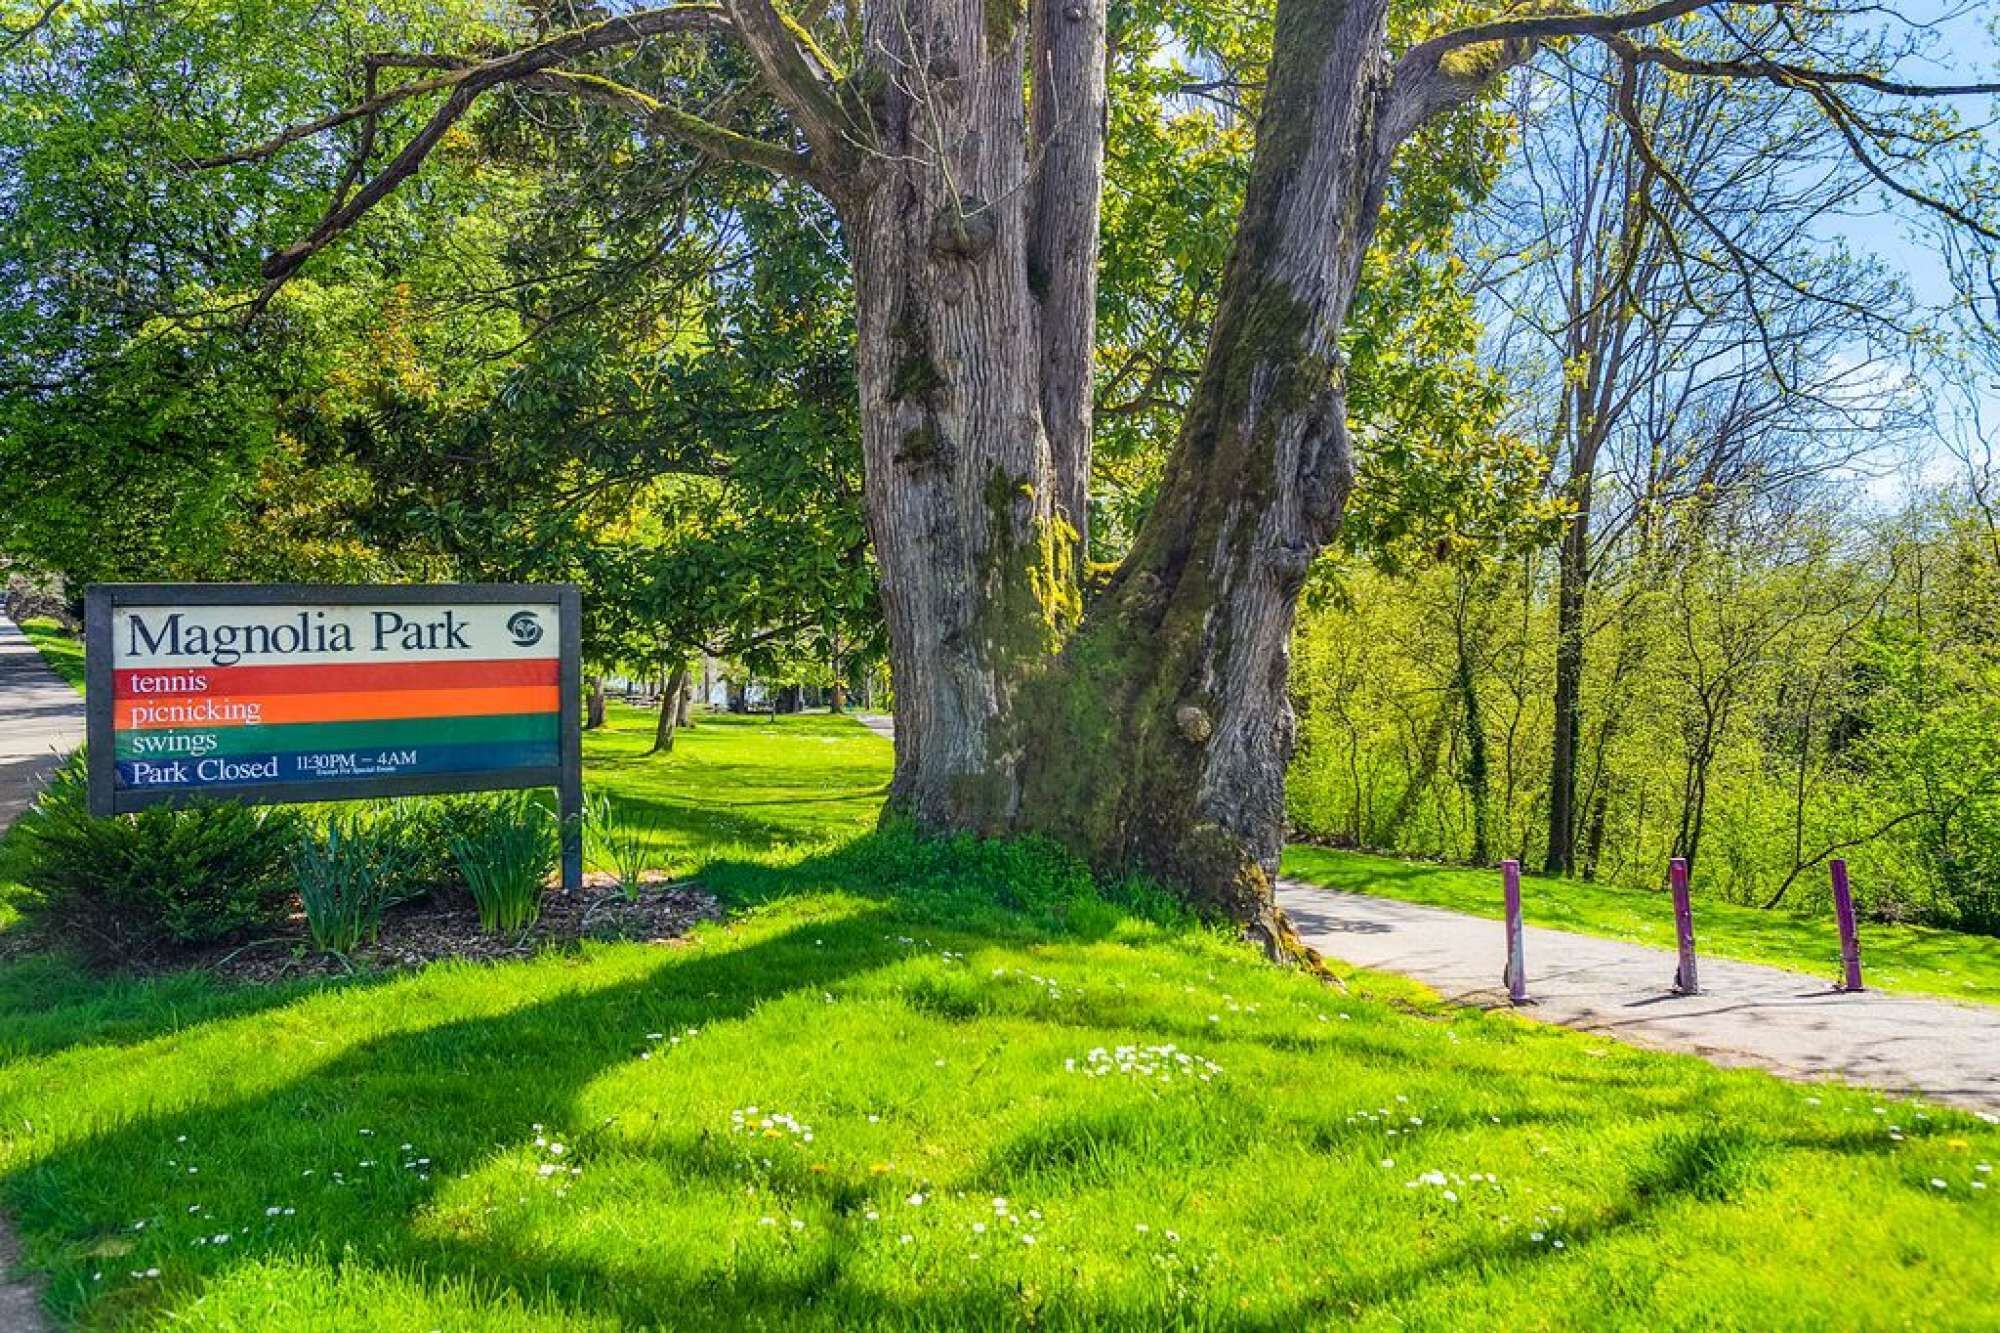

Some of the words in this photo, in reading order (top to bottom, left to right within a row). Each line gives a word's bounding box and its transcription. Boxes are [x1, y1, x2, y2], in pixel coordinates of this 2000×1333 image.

[127, 611, 355, 665] Magnolia
[371, 611, 471, 651] Park
[130, 670, 208, 693] tennis
[131, 700, 262, 729] picnicking
[132, 731, 218, 756] swings
[133, 760, 188, 784] Park
[197, 756, 278, 780] Closed
[377, 750, 417, 765] 4AM
